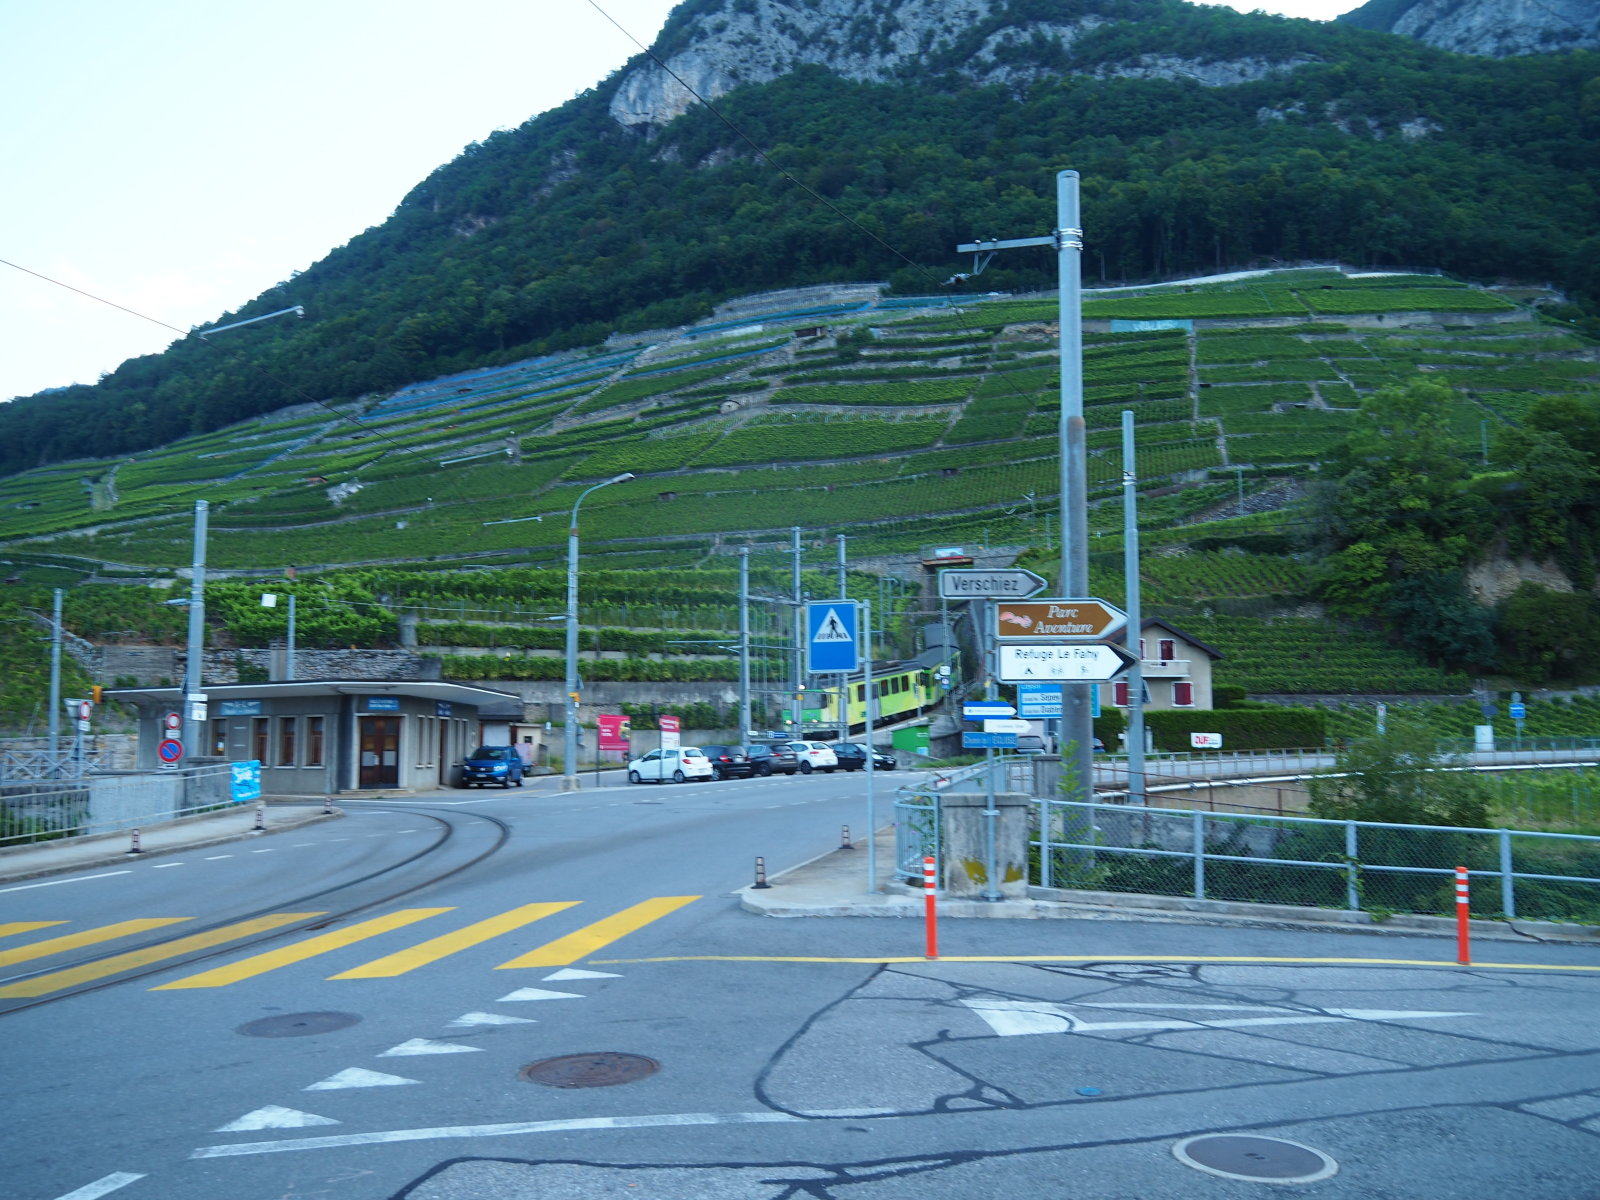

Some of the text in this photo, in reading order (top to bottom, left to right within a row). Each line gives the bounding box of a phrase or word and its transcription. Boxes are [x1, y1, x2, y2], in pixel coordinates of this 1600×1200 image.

[951, 575, 1019, 592] Verschiez
[1047, 605, 1079, 619] Parc
[1033, 621, 1094, 634] Aventure
[1015, 648, 1053, 661] Refuge
[1057, 648, 1071, 660] Le
